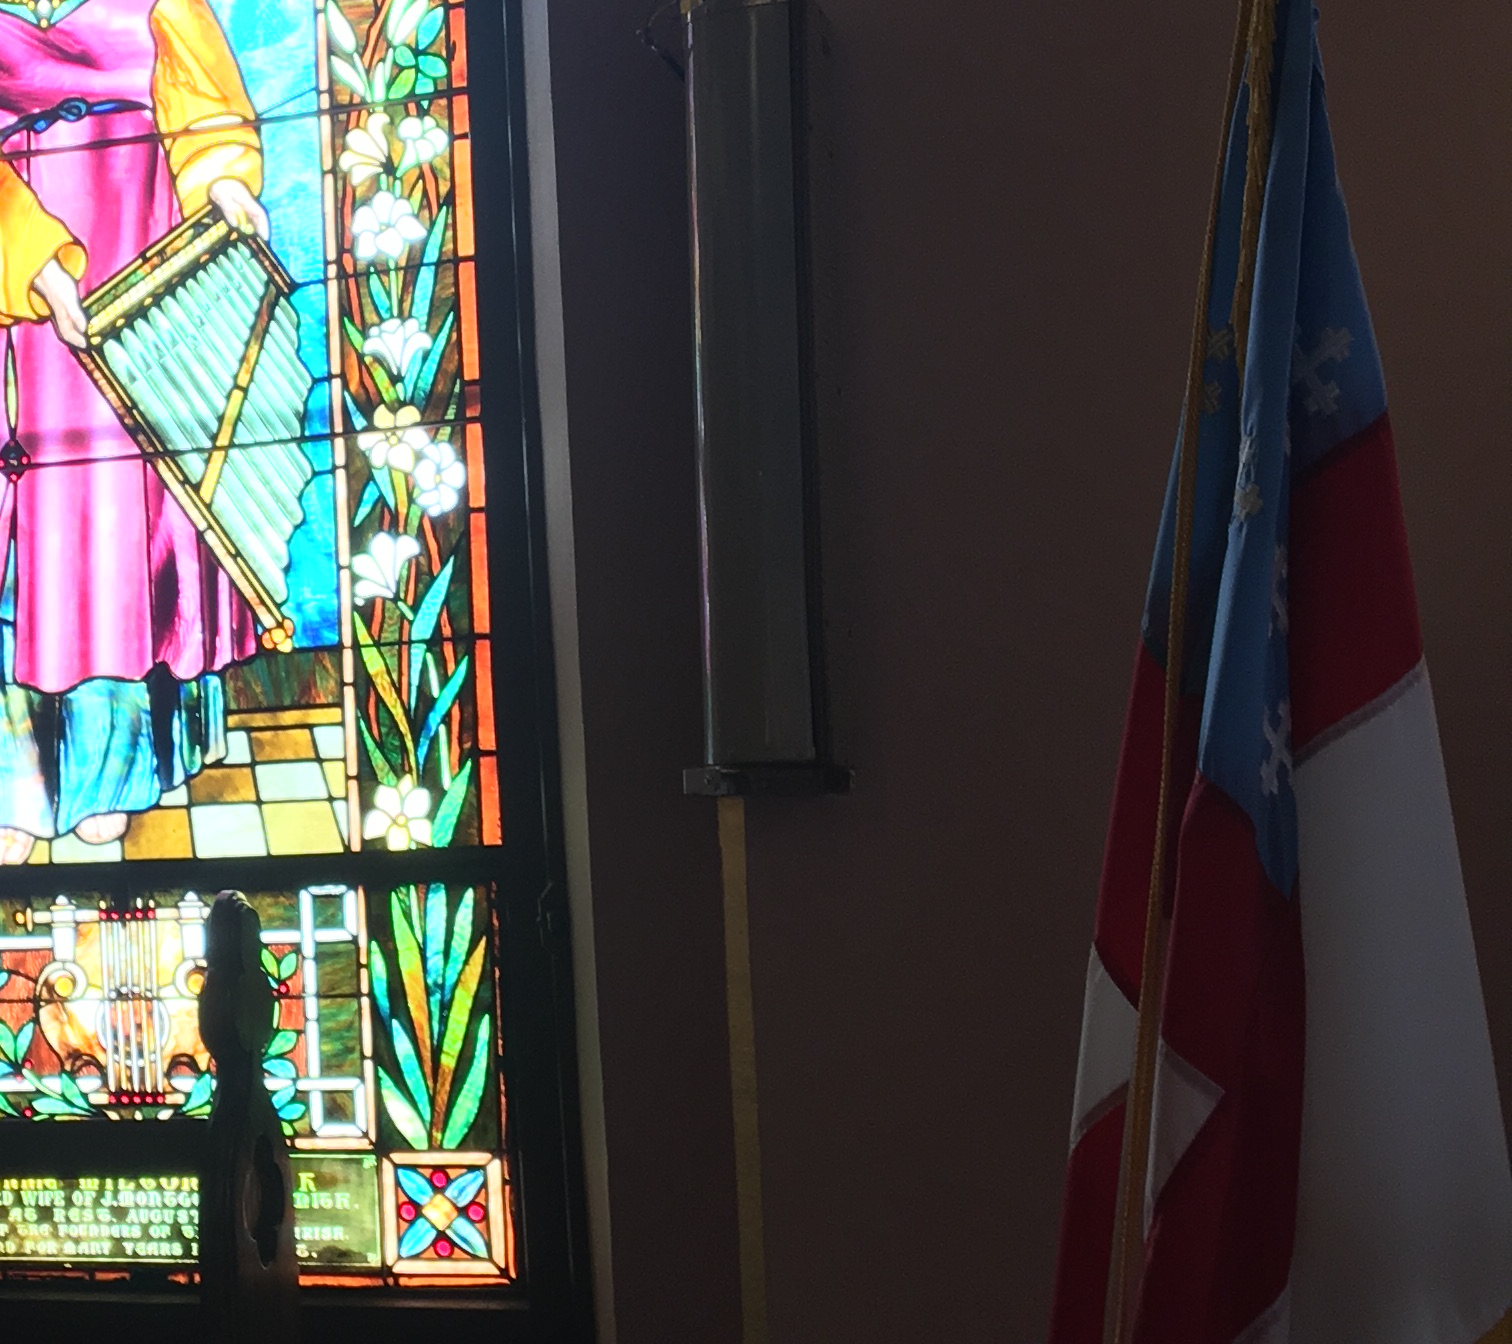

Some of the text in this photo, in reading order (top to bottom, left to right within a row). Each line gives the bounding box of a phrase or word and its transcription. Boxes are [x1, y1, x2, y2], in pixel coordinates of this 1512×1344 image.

[20, 1190, 65, 1207] WIFE
[71, 1190, 96, 1207] OF
[57, 1224, 142, 1238] FOUNDERS
[148, 1225, 171, 1238] OF
[23, 1241, 58, 1254] FOR
[63, 1241, 111, 1255] MANY
[122, 1242, 184, 1256] YEARS
